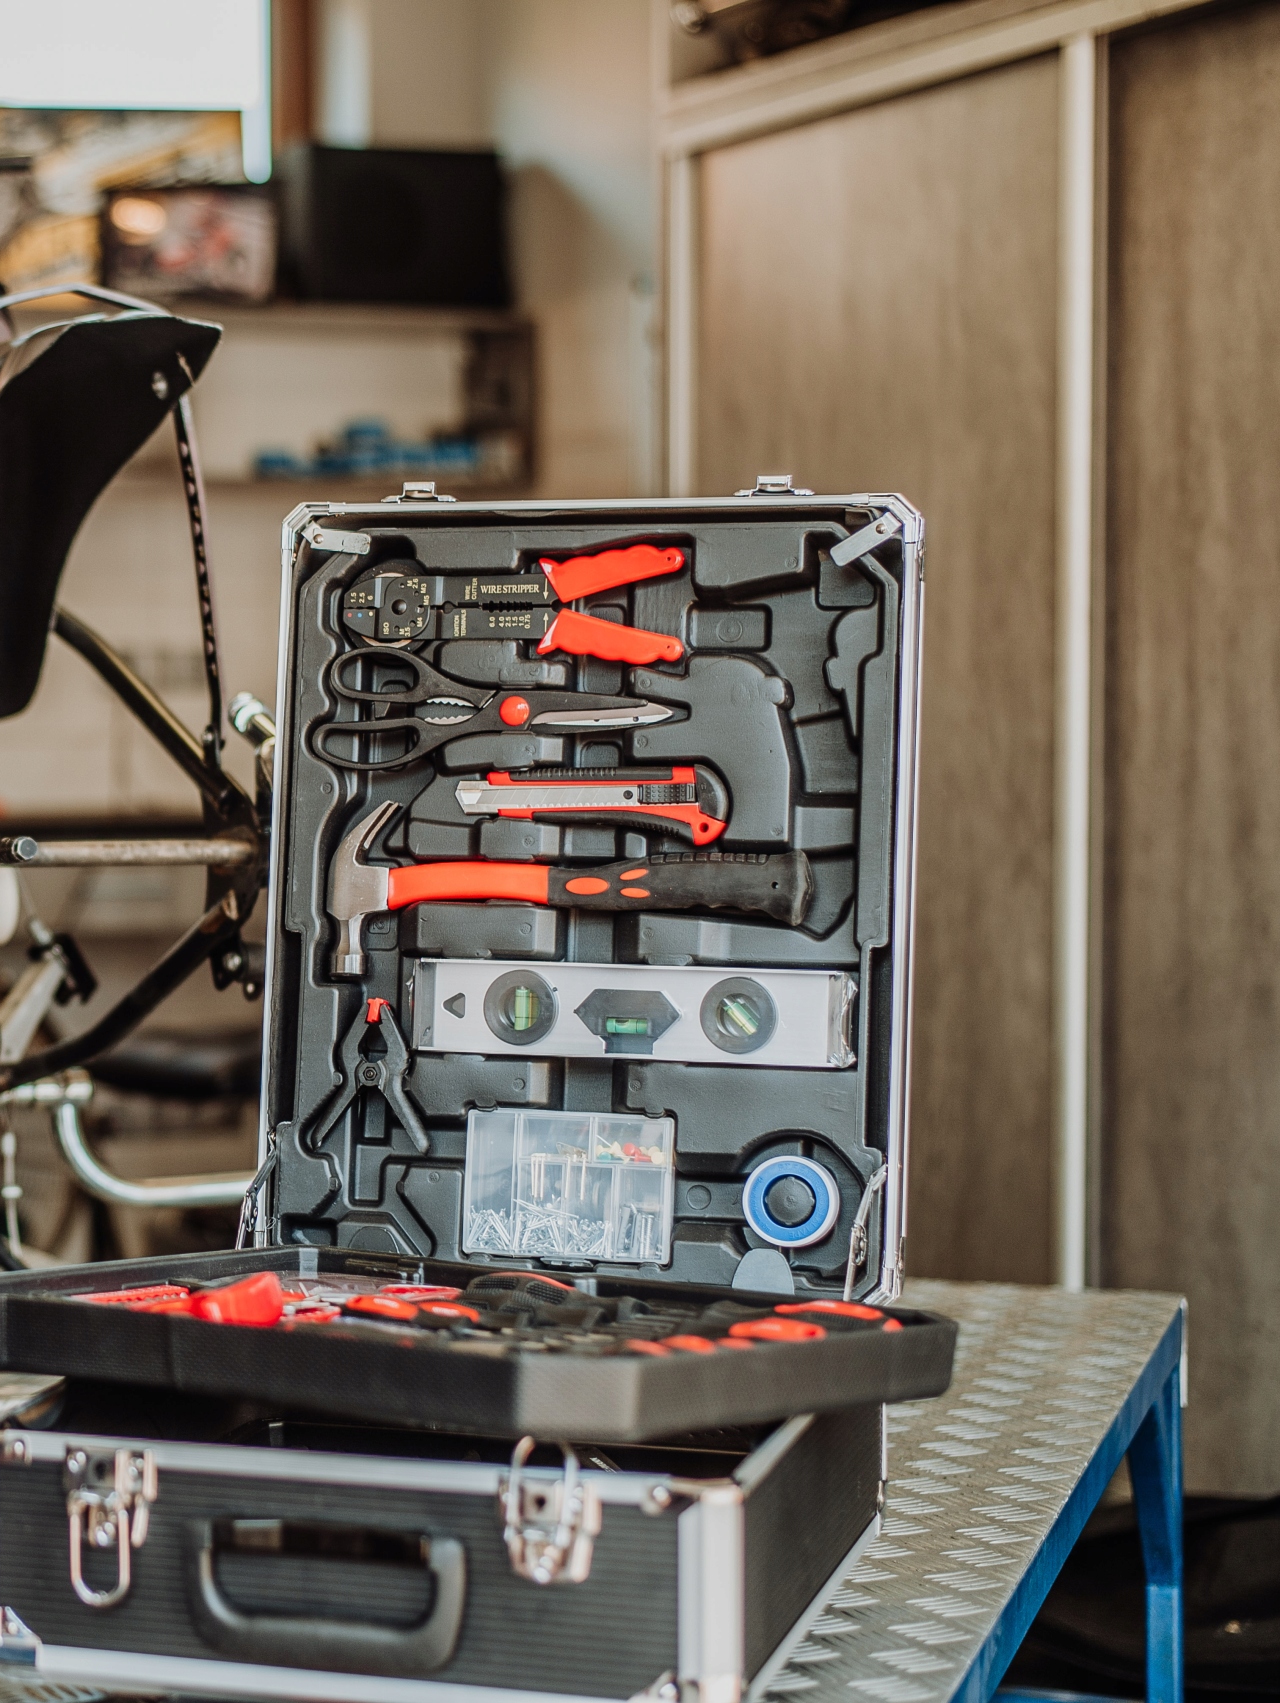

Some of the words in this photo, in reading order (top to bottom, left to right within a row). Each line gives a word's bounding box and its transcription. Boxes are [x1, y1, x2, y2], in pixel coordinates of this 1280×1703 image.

[420, 583, 427, 594] M3
[480, 585, 502, 594] WIRE
[502, 584, 540, 594] STRIPPER
[358, 592, 366, 603] 2.5
[423, 595, 430, 606] M5
[416, 617, 423, 627] M4
[382, 622, 390, 635] ISO
